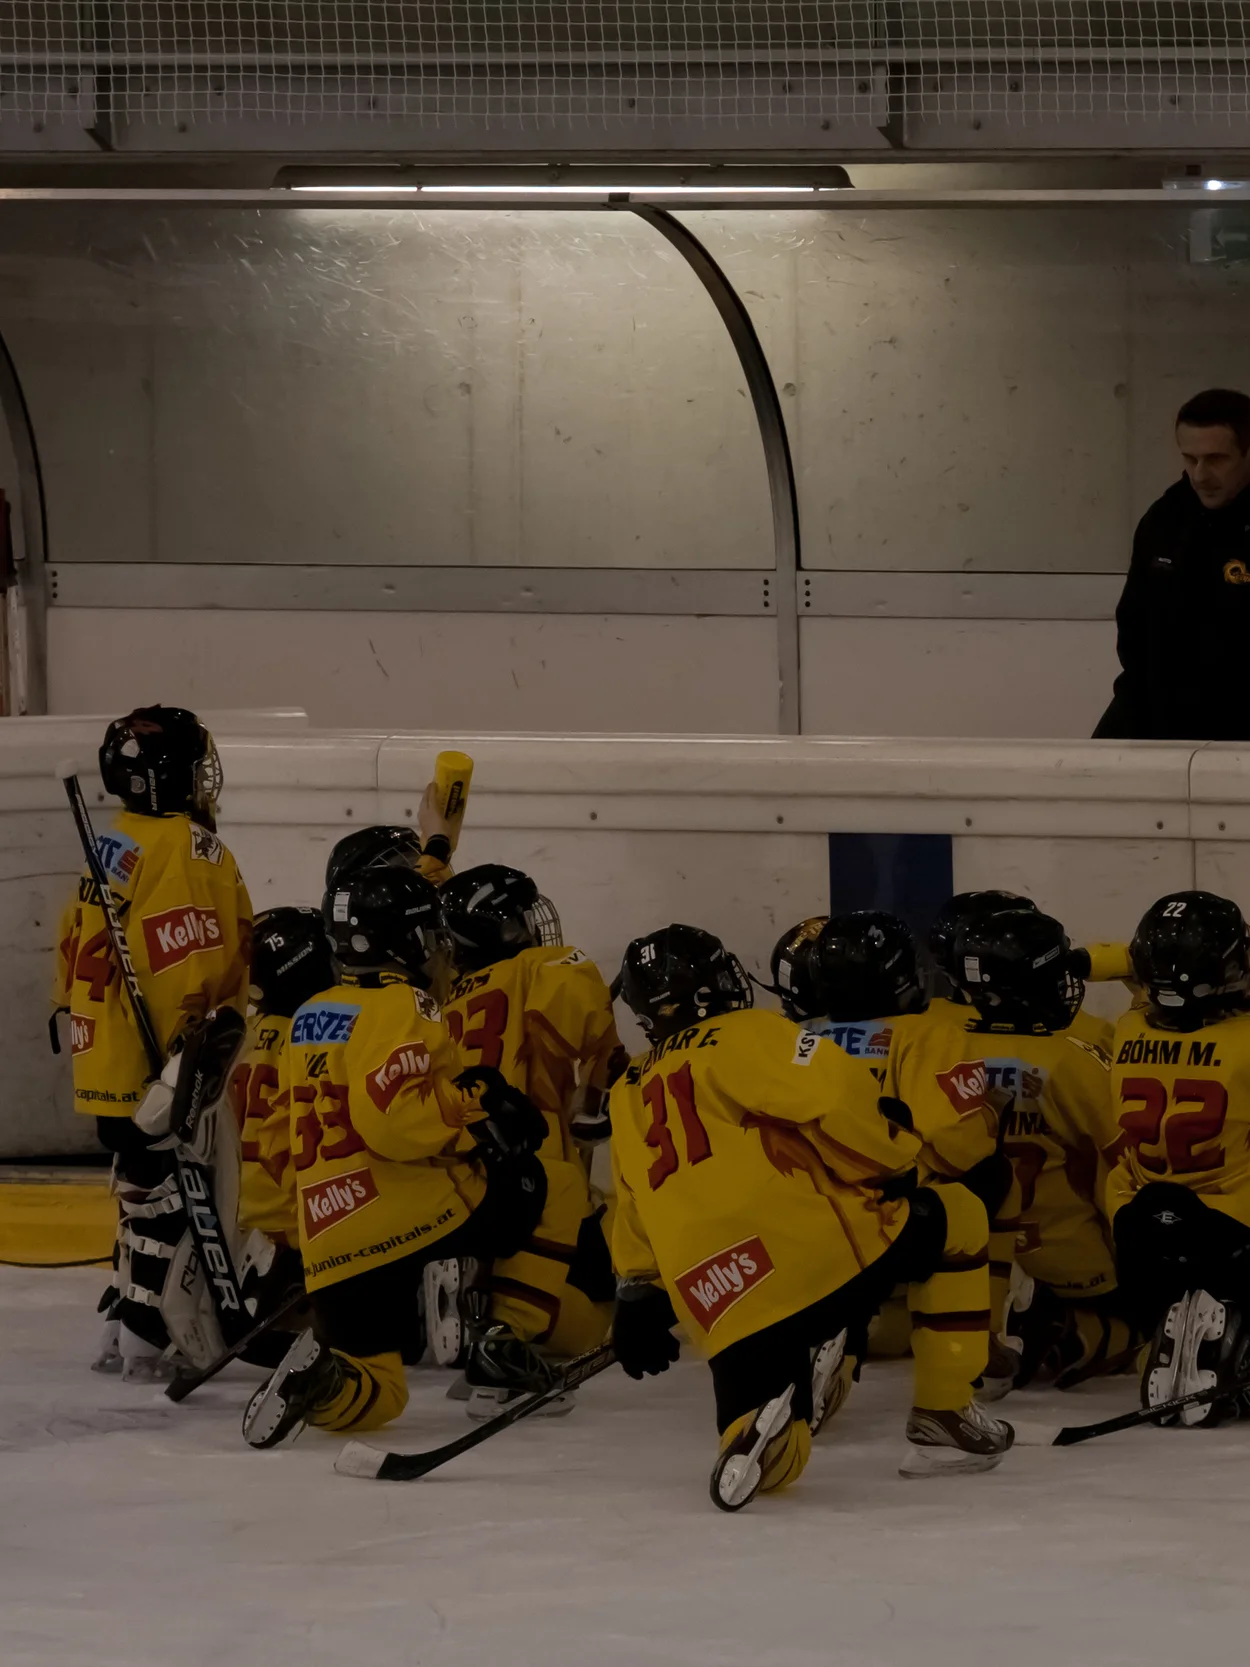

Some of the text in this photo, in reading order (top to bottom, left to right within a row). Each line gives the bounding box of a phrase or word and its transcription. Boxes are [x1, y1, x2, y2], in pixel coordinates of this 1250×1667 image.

[1162, 901, 1188, 918] 22
[100, 883, 144, 998] BAUER
[155, 911, 221, 954] Kelly's
[264, 932, 285, 953] 75
[276, 941, 315, 977] MISSION
[640, 942, 656, 965] 31
[71, 1020, 90, 1049] lly's
[291, 1010, 354, 1044] ERSTE
[1116, 1033, 1222, 1067] BÖHM M.
[184, 1069, 206, 1130] Reebok
[642, 1061, 713, 1192] 31
[1117, 1077, 1229, 1174] 22
[307, 1178, 367, 1223] Kelly's
[689, 1252, 758, 1312] Kelly's
